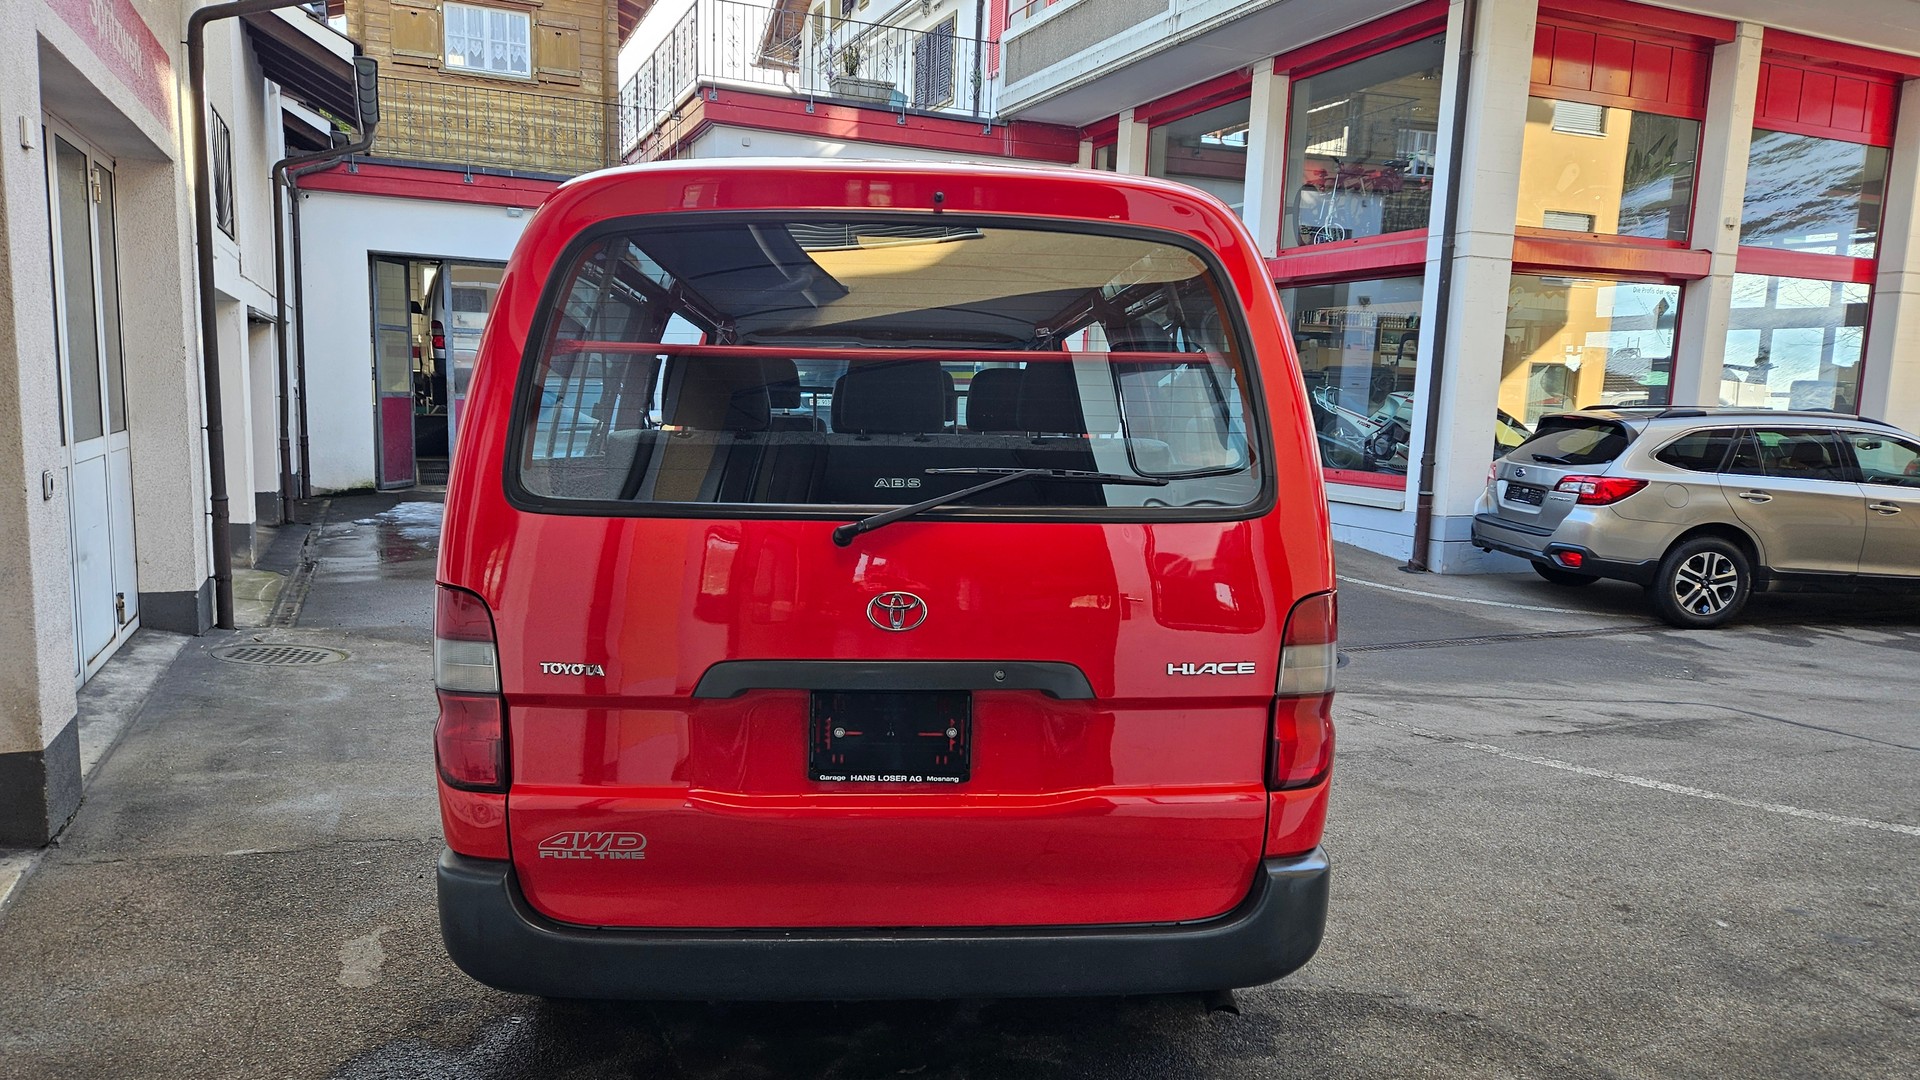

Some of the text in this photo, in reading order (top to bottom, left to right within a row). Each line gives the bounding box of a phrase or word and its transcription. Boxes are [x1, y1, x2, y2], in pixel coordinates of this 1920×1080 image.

[1632, 286, 1641, 294] Die
[874, 477, 921, 488] ABS
[540, 662, 605, 677] TOYOTA
[1167, 662, 1256, 676] HIACE
[819, 774, 960, 784] Garage HANS LOSER AG Mosnang
[538, 831, 647, 852] 4WD
[540, 850, 645, 860] FULL TIME
